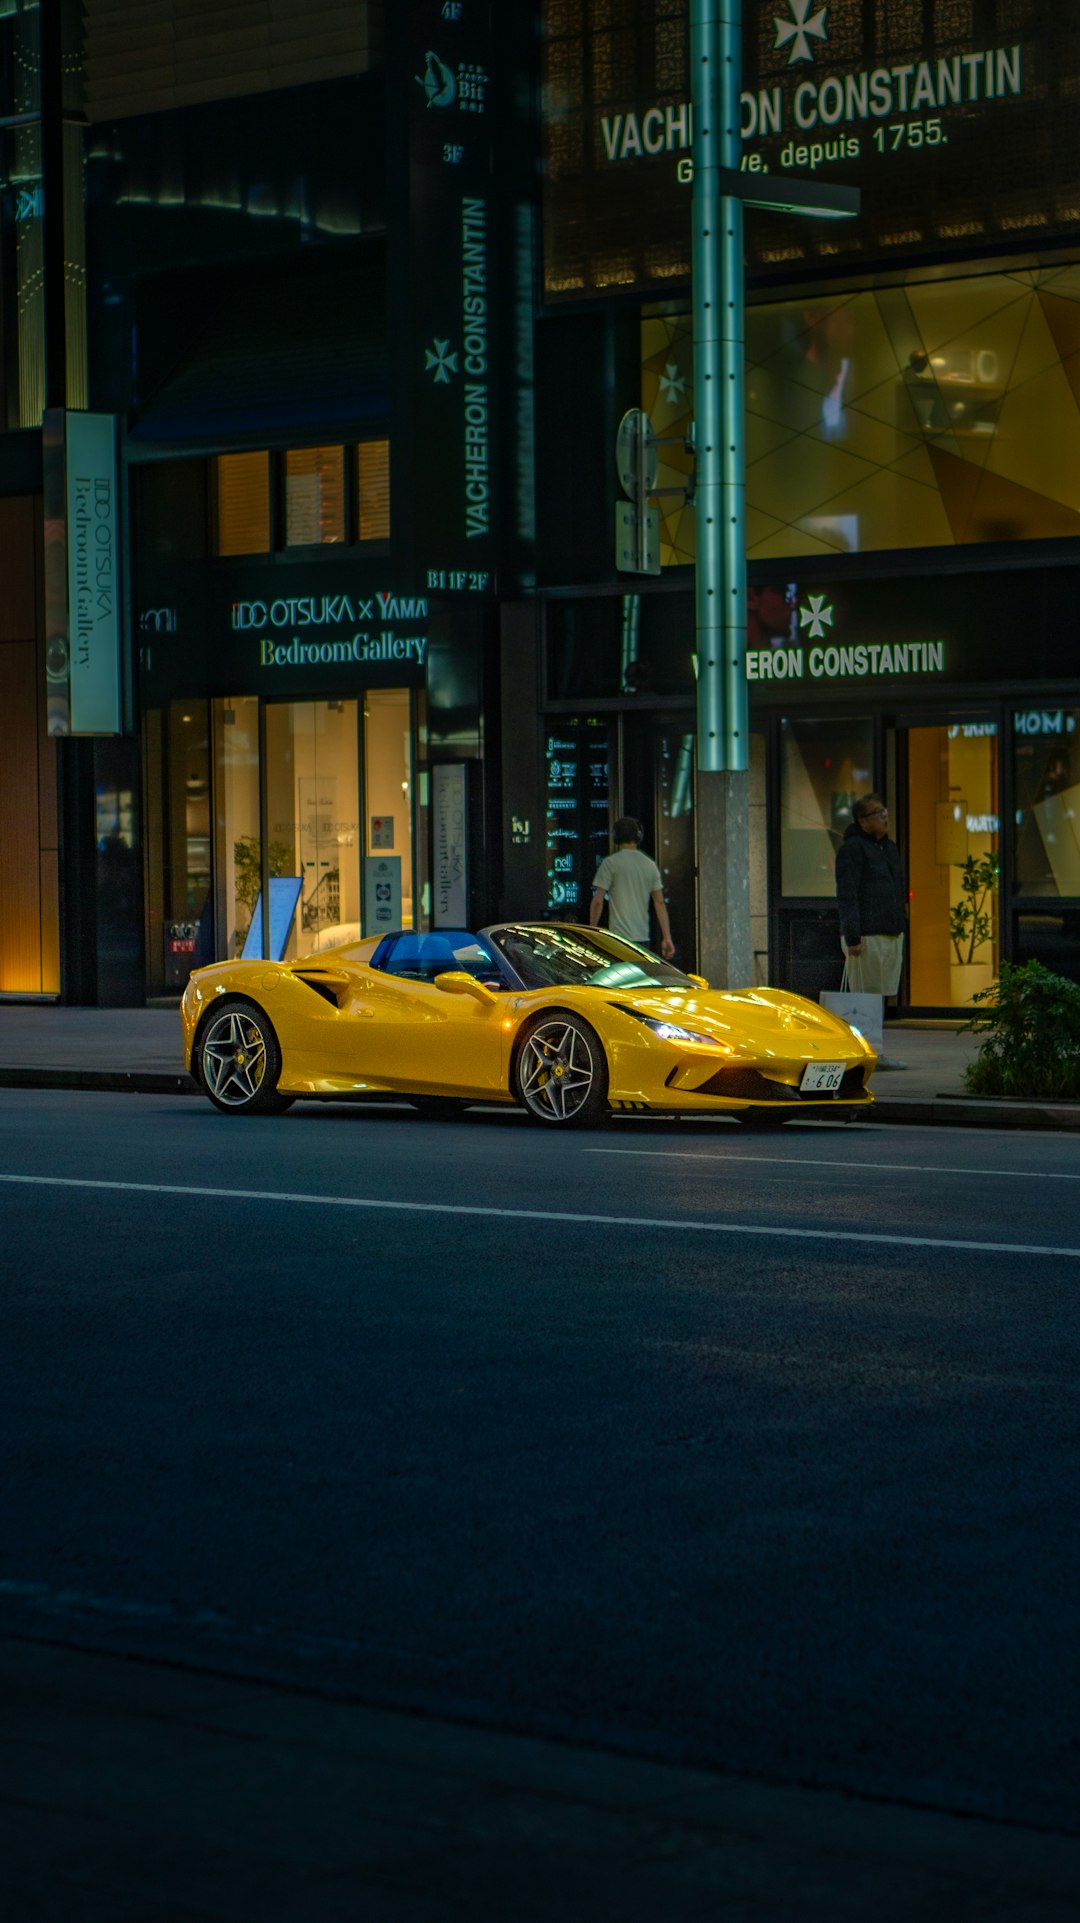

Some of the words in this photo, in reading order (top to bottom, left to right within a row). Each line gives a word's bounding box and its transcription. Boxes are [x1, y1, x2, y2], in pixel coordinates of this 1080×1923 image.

[600, 85, 783, 161] VACHON
[793, 45, 1022, 132] CONSTANTIN
[442, 143, 464, 163] 3F
[780, 133, 861, 170] depuis
[872, 118, 949, 153] 1755.
[461, 196, 487, 377] CONSTANTIN
[463, 383, 490, 540] VACHERON
[74, 477, 94, 670] BedroomGallery
[95, 524, 112, 622] OTSUKA
[468, 571, 489, 591] 2F
[270, 595, 355, 627] OTSUKA
[260, 630, 428, 666] BedroomGallery
[808, 641, 944, 678] CONSTANTIN
